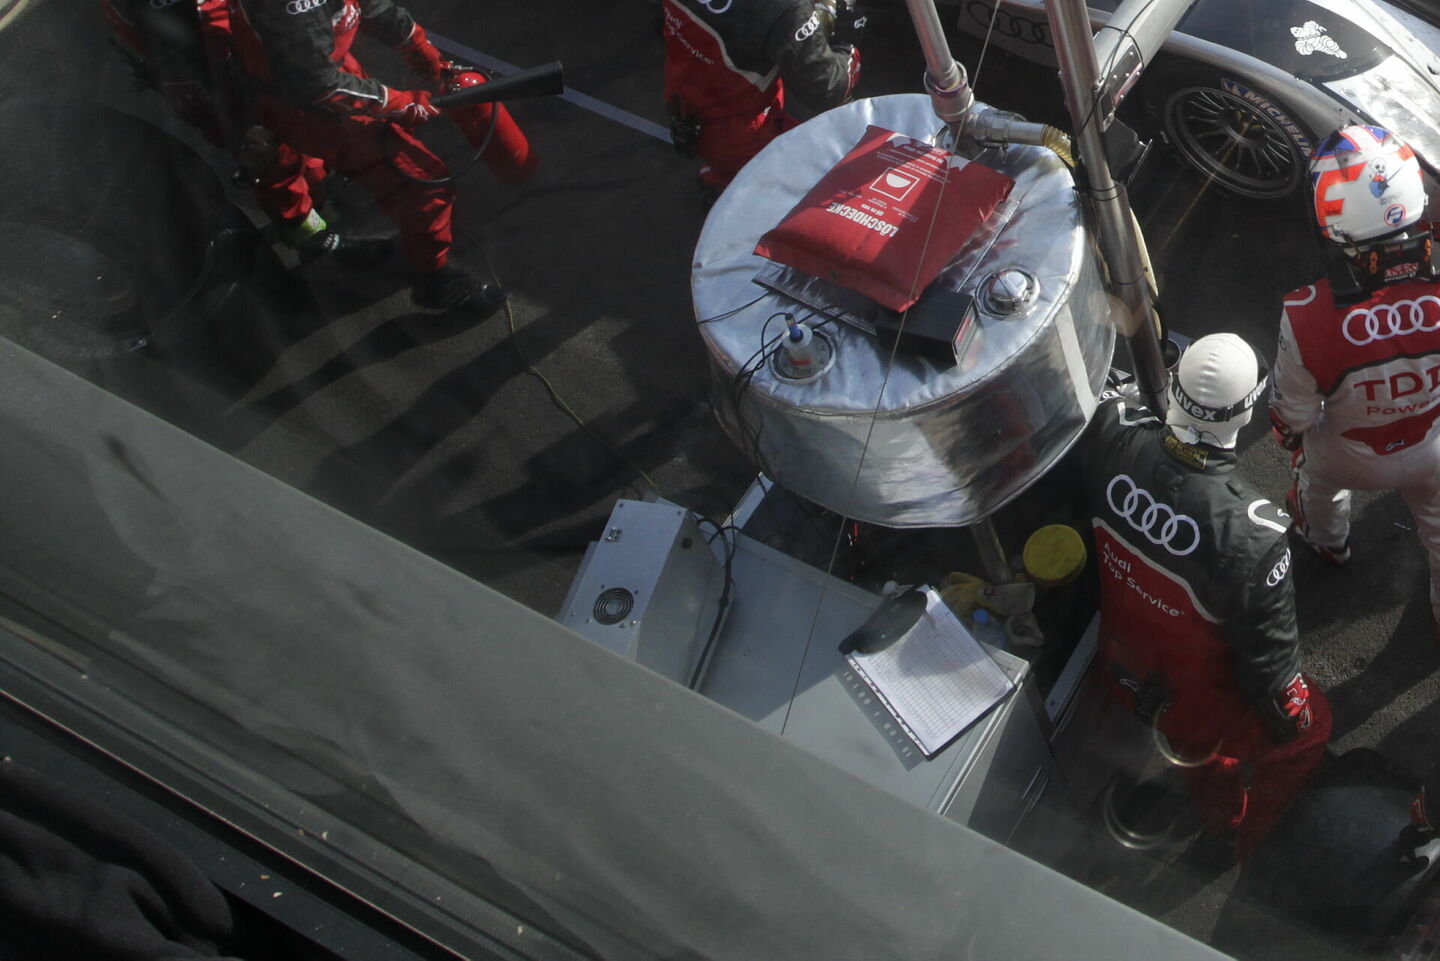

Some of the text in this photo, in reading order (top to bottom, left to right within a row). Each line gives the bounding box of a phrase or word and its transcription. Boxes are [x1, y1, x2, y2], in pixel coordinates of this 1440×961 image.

[826, 201, 900, 237] LÖSCHDECKE
[1175, 386, 1217, 420] uvex
[1104, 542, 1131, 573] Audi
[1126, 577, 1180, 617] Service
